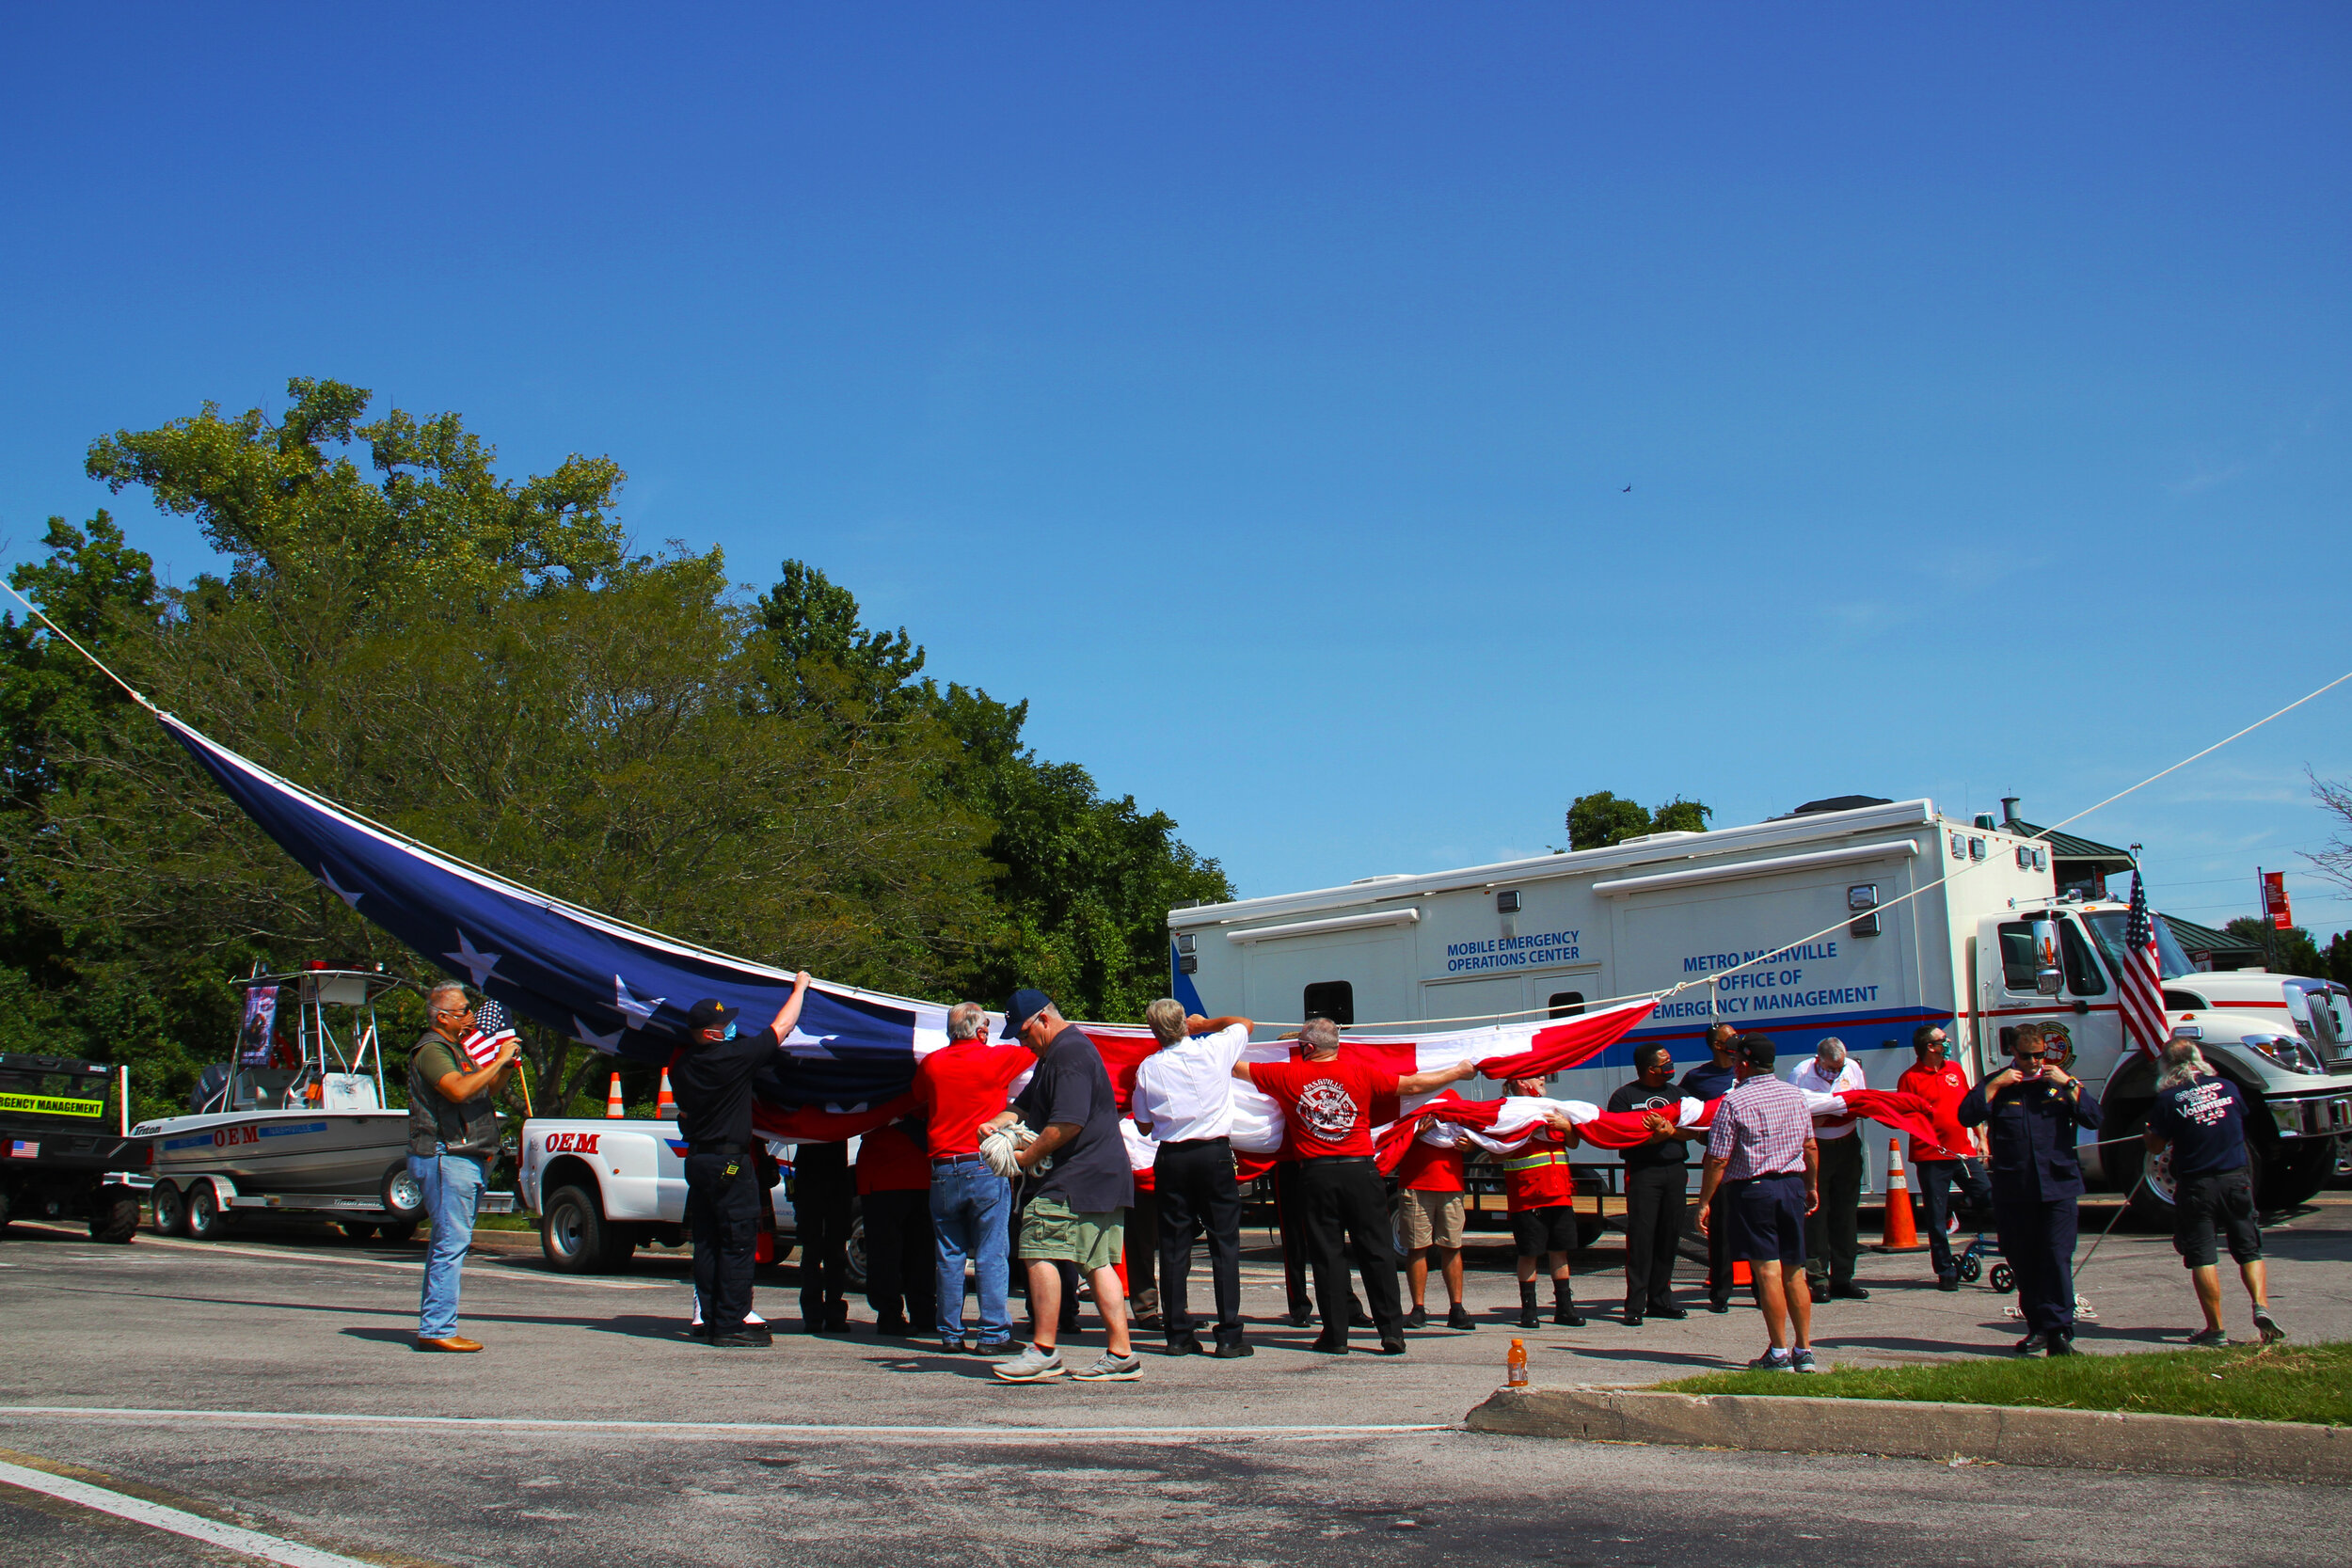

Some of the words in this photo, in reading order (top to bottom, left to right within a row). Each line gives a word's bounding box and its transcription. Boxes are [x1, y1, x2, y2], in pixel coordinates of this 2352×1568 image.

[1448, 940, 1495, 957] MOBILE
[1499, 930, 1580, 951] EMERGENCY
[1447, 952, 1526, 972] OPERATIONS
[1529, 946, 1580, 963] CENTER
[1683, 952, 1740, 973] METRO
[1743, 942, 1837, 966] NASHVILLE
[1719, 972, 1775, 991] OFFICE
[1780, 969, 1803, 985] OF
[1754, 985, 1879, 1011] MANAGEMENT
[1303, 1078, 1344, 1092] NASHVILLE
[2175, 1082, 2223, 1101] GROUND
[37, 1100, 101, 1115] MANAGEMENT
[2176, 1096, 2233, 1117] VOLUNTEERS
[134, 1125, 162, 1136] Triton
[214, 1125, 260, 1148] OEM
[546, 1132, 601, 1155] OEM
